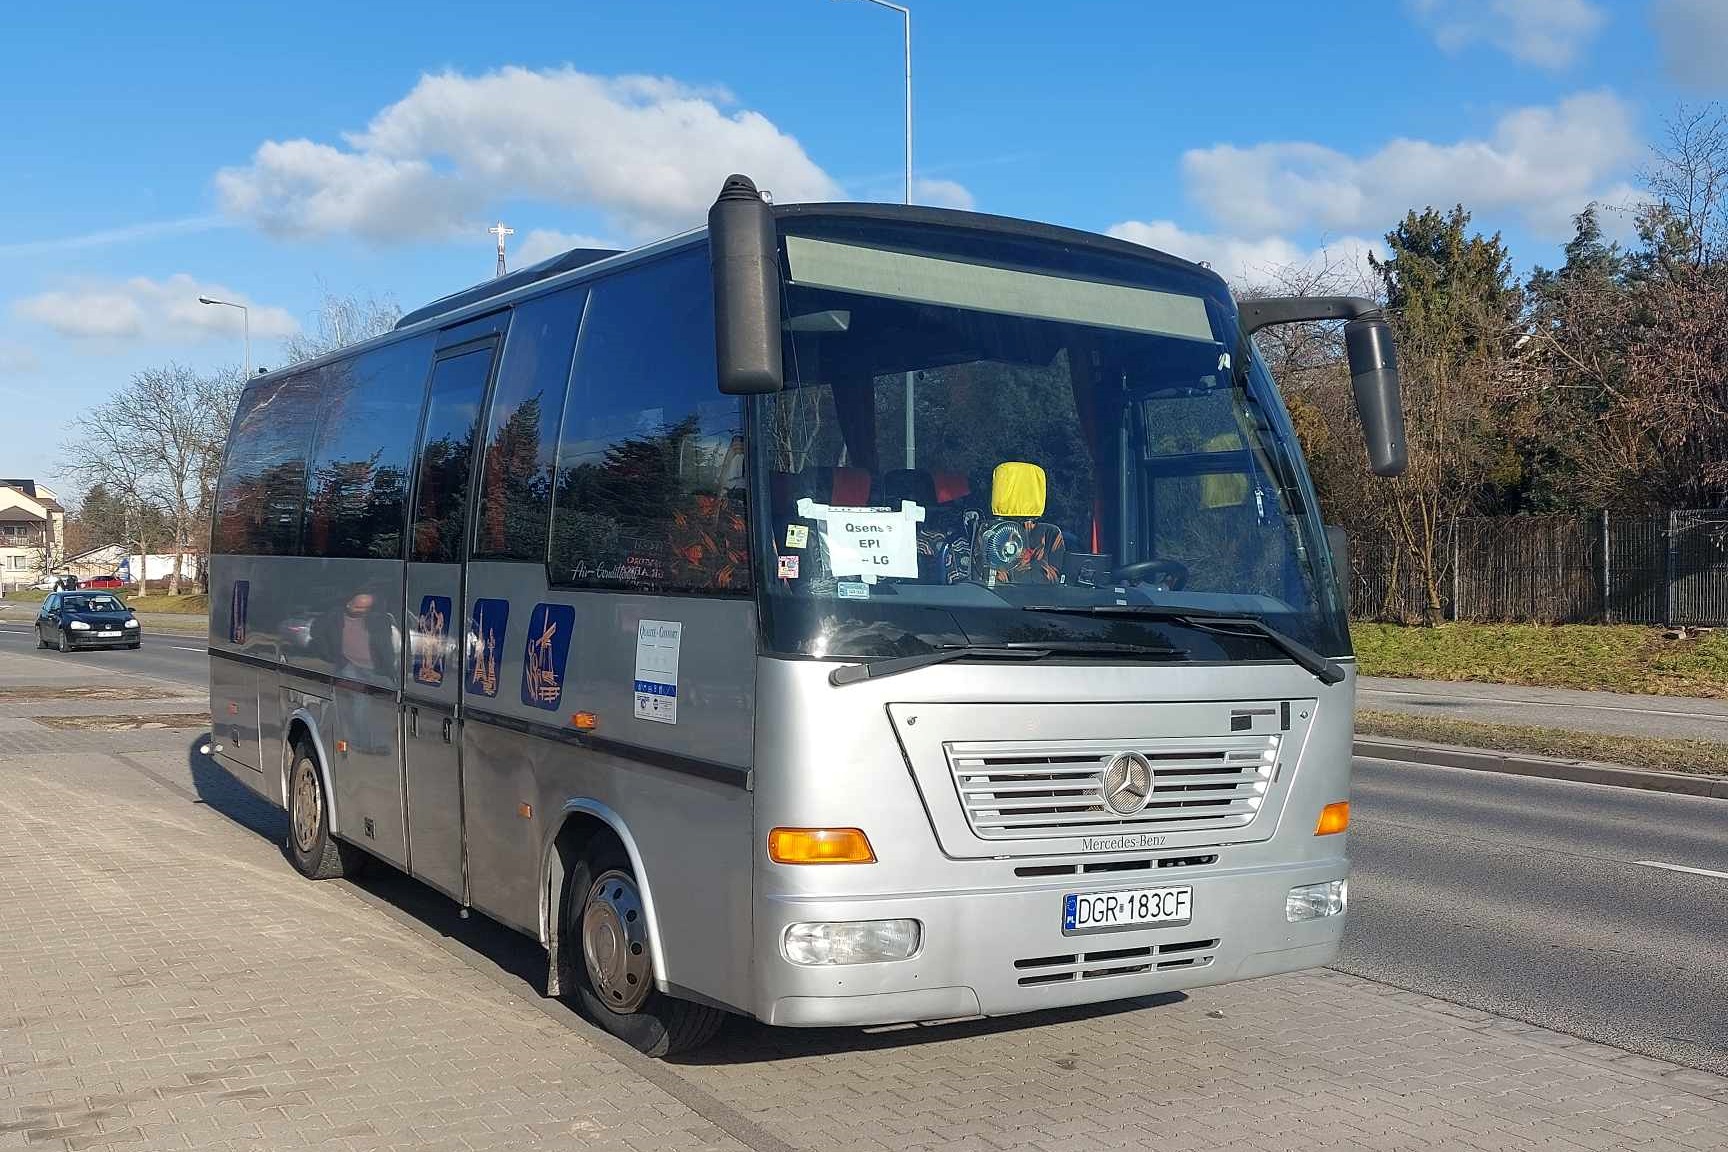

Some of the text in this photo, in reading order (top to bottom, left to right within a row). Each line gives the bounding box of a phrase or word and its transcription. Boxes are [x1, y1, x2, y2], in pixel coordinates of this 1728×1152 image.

[873, 555, 889, 565] LG
[1082, 834, 1166, 851] Mercedes-Benz
[1078, 896, 1118, 924] DGR
[1128, 891, 1188, 919] 183CF
